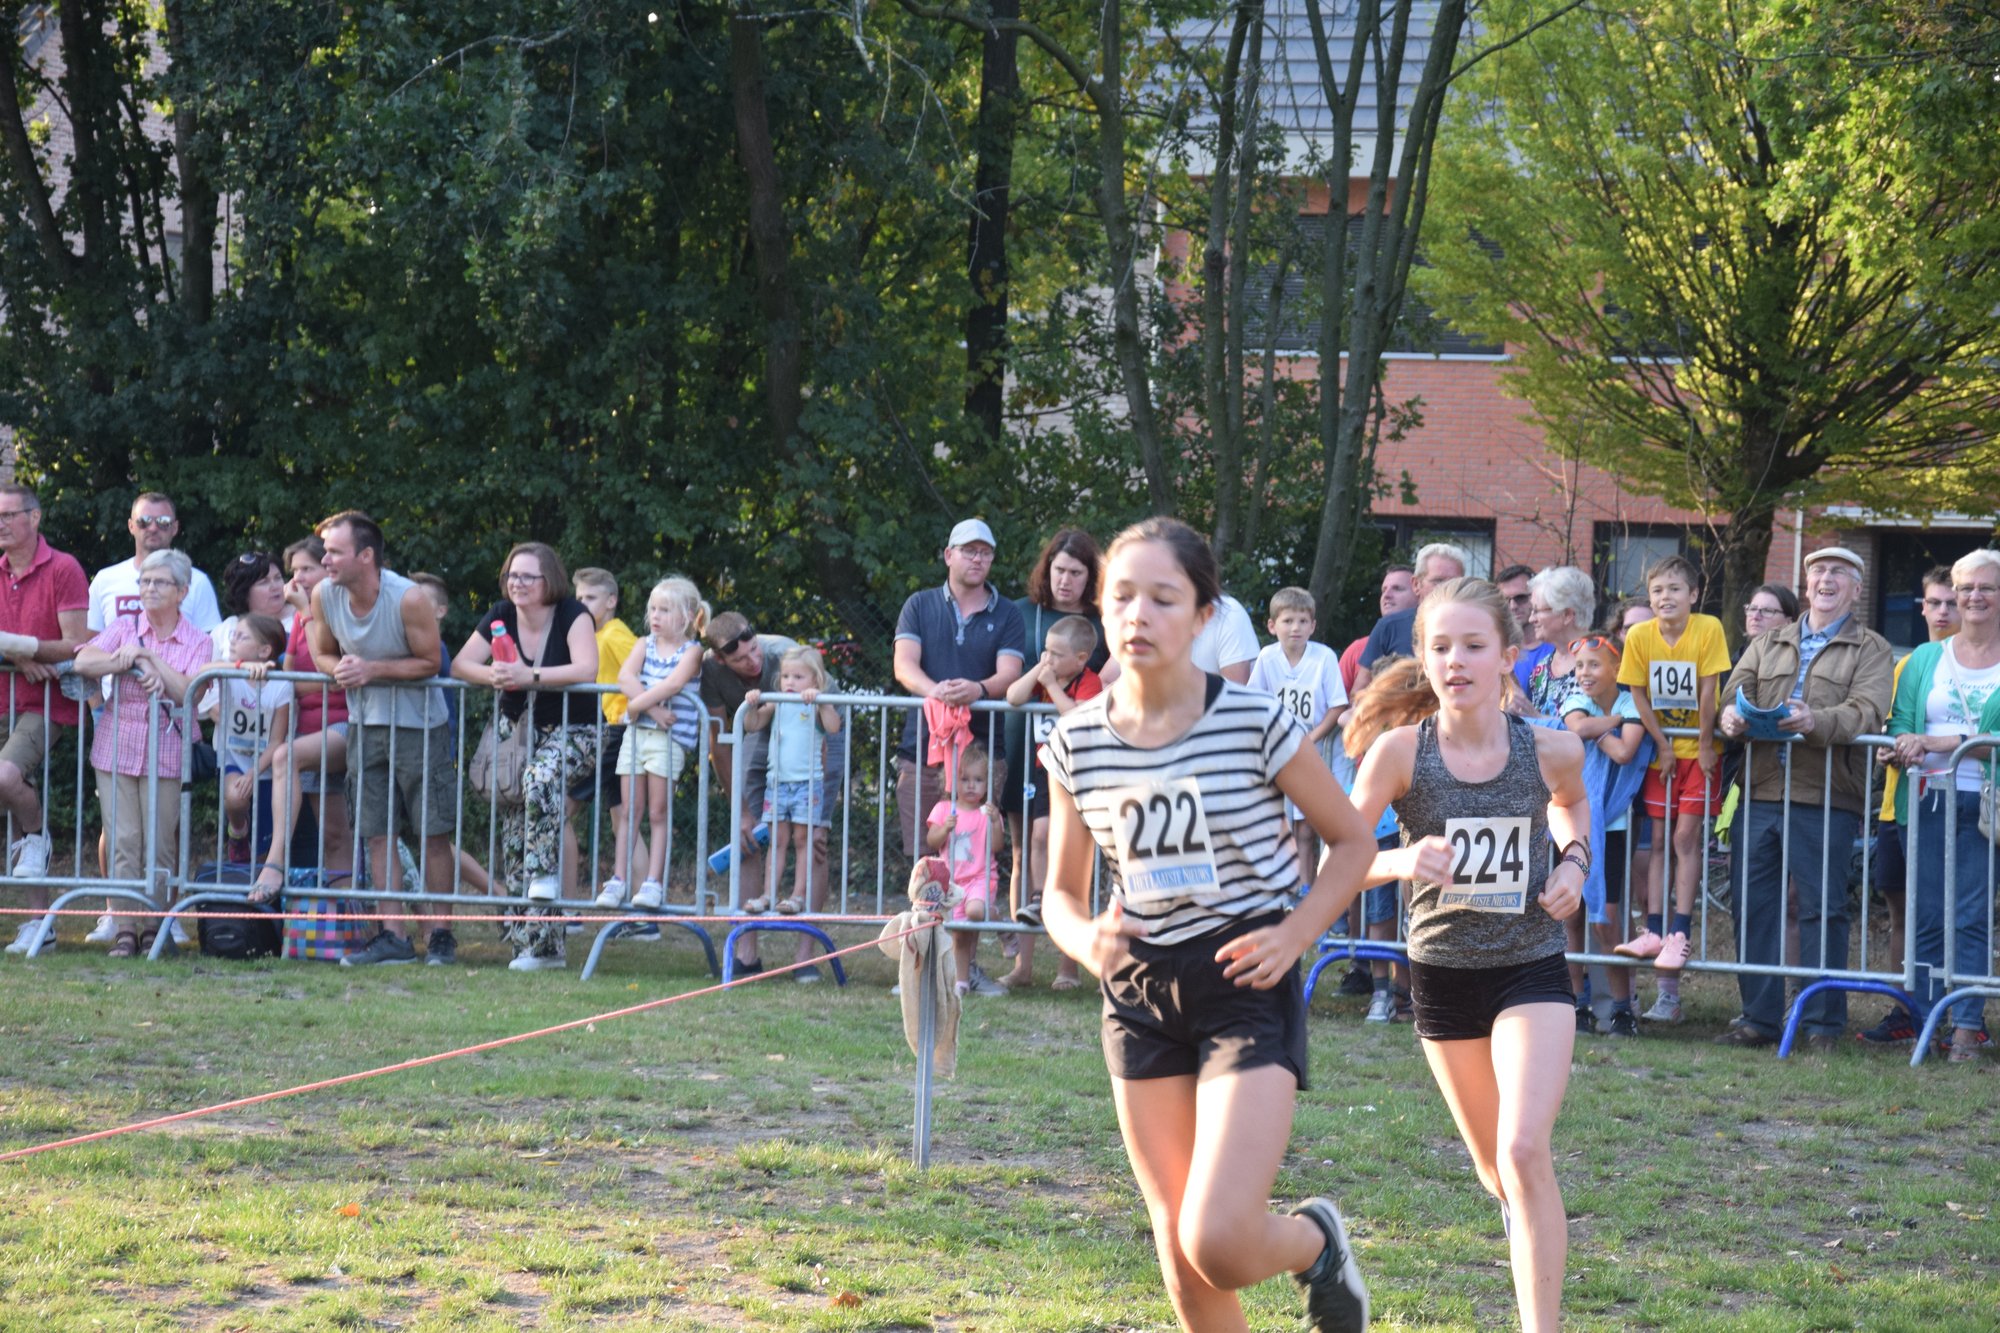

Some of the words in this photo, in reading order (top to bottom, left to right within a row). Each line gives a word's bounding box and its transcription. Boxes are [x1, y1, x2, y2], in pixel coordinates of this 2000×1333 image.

[1653, 665, 1694, 697] 194
[1277, 687, 1312, 720] 136
[232, 709, 267, 737] 94
[1119, 790, 1207, 862] 222
[1450, 826, 1524, 885] 224
